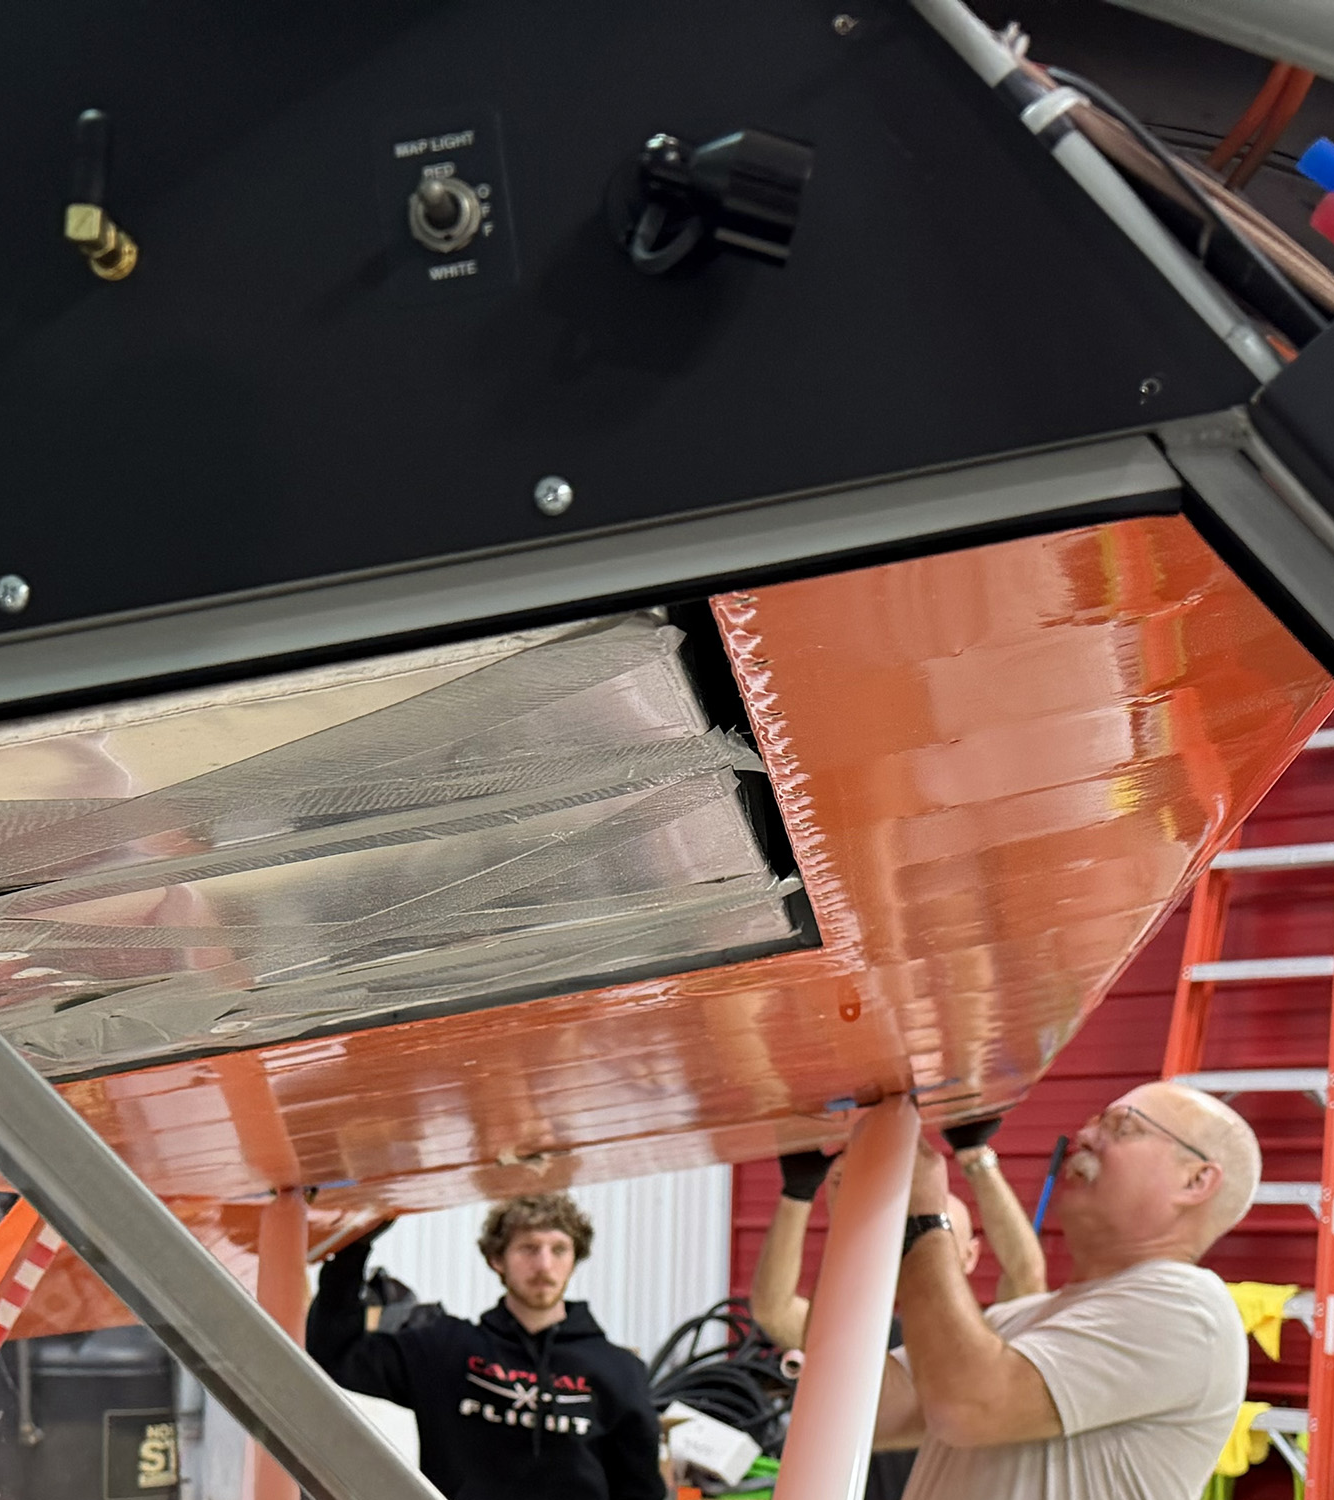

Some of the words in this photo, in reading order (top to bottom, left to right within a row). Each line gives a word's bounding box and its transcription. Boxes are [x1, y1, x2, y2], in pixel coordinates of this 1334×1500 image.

[394, 139, 427, 159] MAP
[431, 130, 475, 154] LIGHT
[429, 259, 477, 282] WHITE
[467, 1355, 592, 1393] CAPIAL
